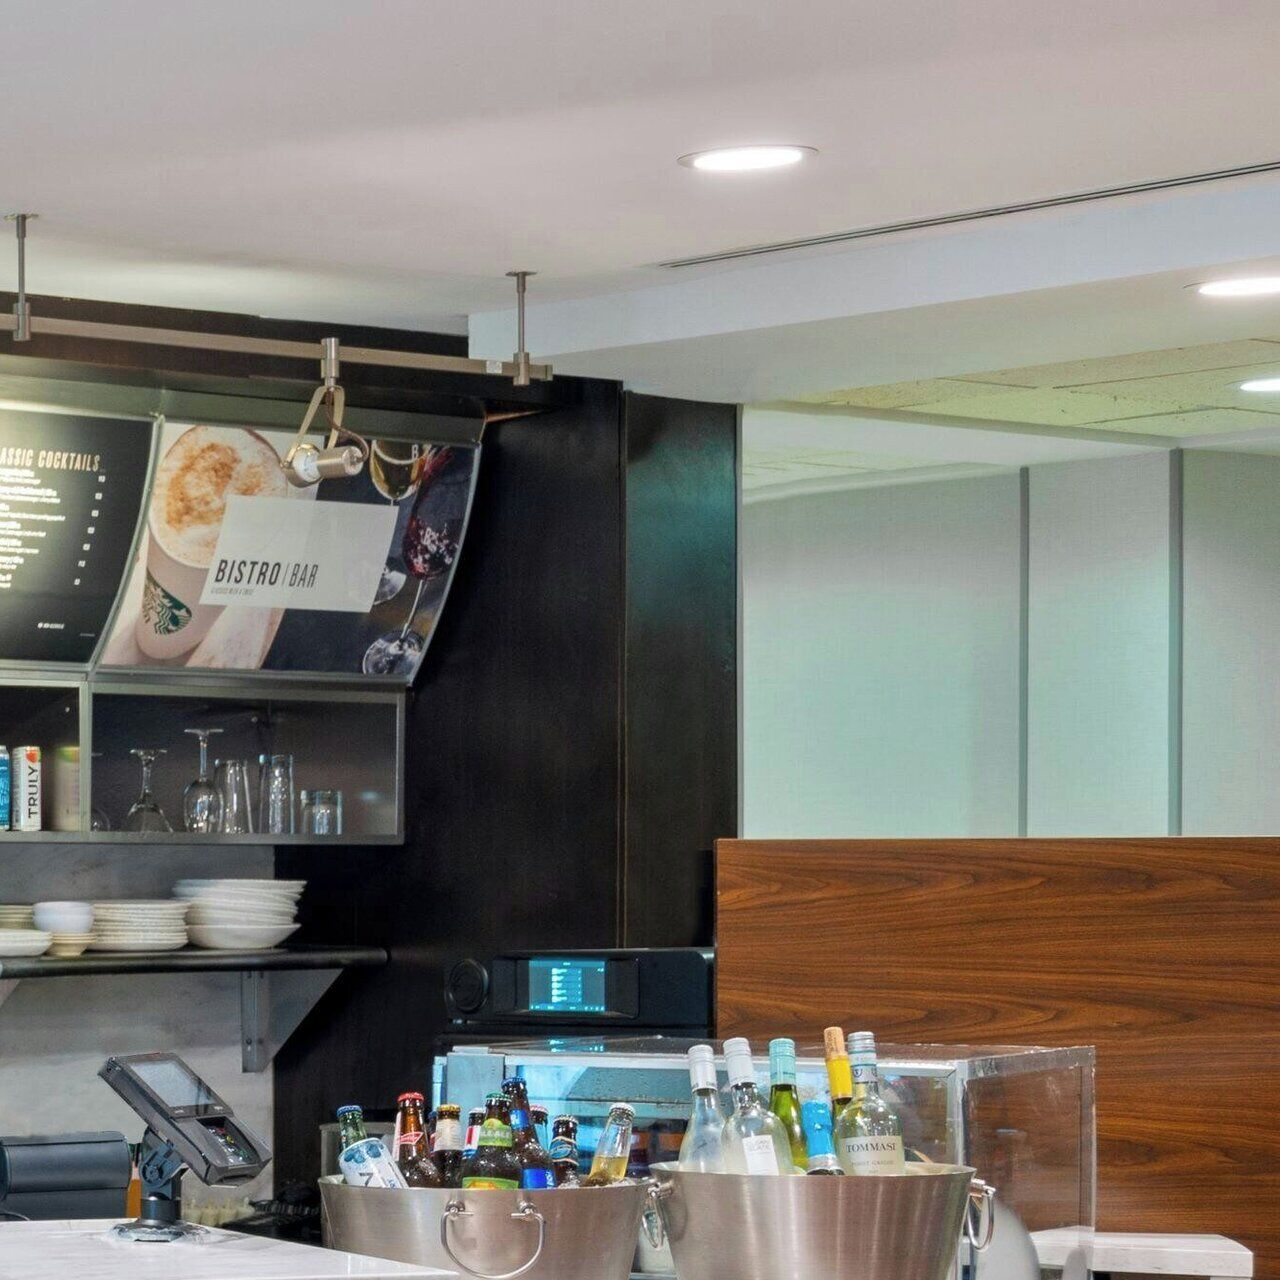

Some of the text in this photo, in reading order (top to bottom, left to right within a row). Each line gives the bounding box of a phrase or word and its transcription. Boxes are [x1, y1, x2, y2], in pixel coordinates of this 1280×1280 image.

[37, 450, 101, 472] COCKTAILS
[214, 559, 319, 588] BISTRO BAR
[28, 765, 38, 820] TRULY
[845, 1142, 897, 1153] TOMMASI
